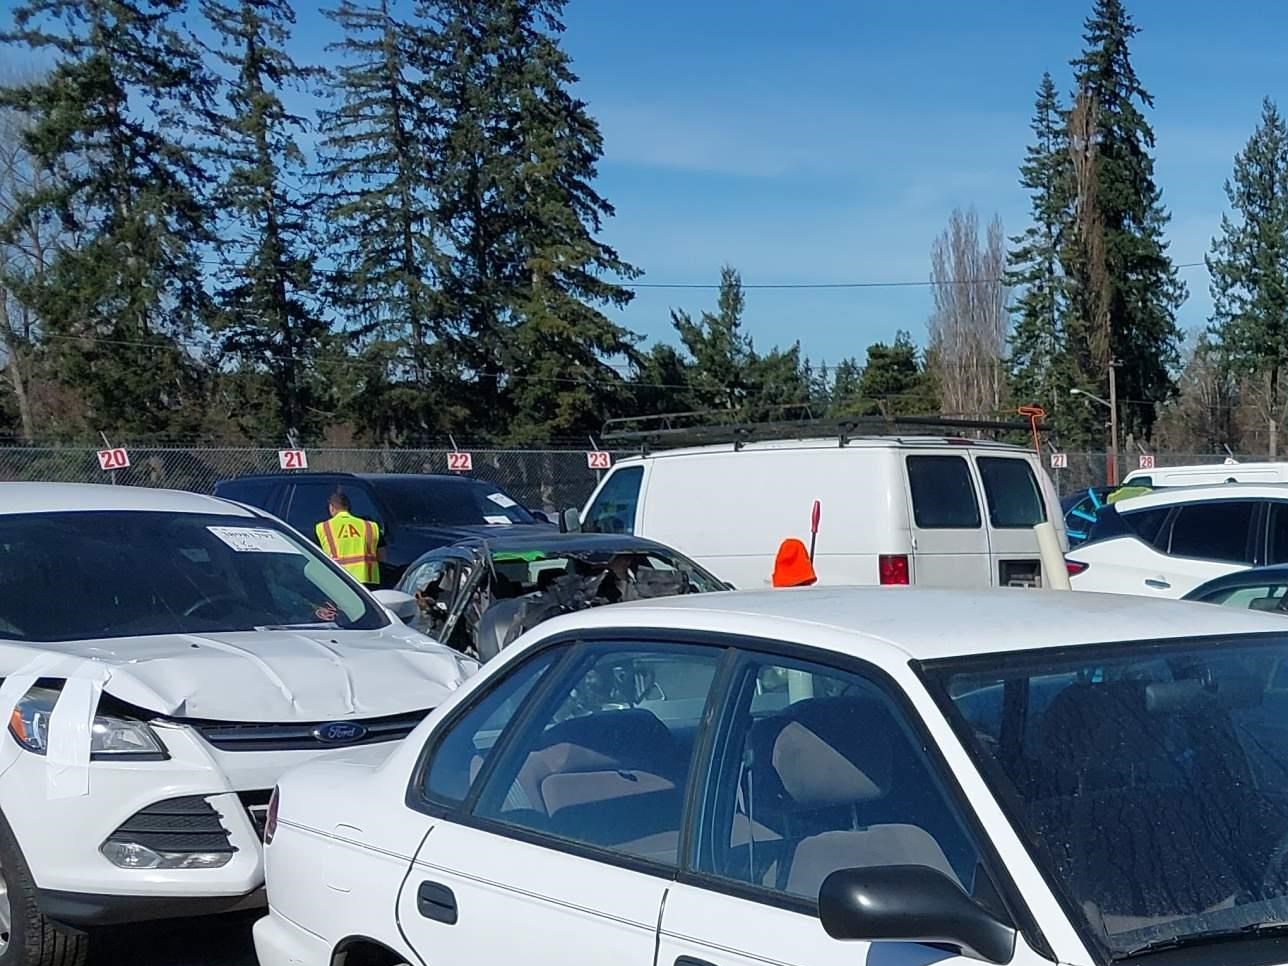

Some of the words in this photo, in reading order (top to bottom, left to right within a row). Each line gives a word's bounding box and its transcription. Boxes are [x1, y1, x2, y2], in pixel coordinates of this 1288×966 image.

[101, 450, 127, 468] 20
[284, 451, 304, 468] 21
[450, 454, 470, 469] 22
[590, 453, 609, 467] 23
[1053, 455, 1065, 467] 27
[1141, 457, 1153, 468] 28
[328, 725, 356, 739] Ford
